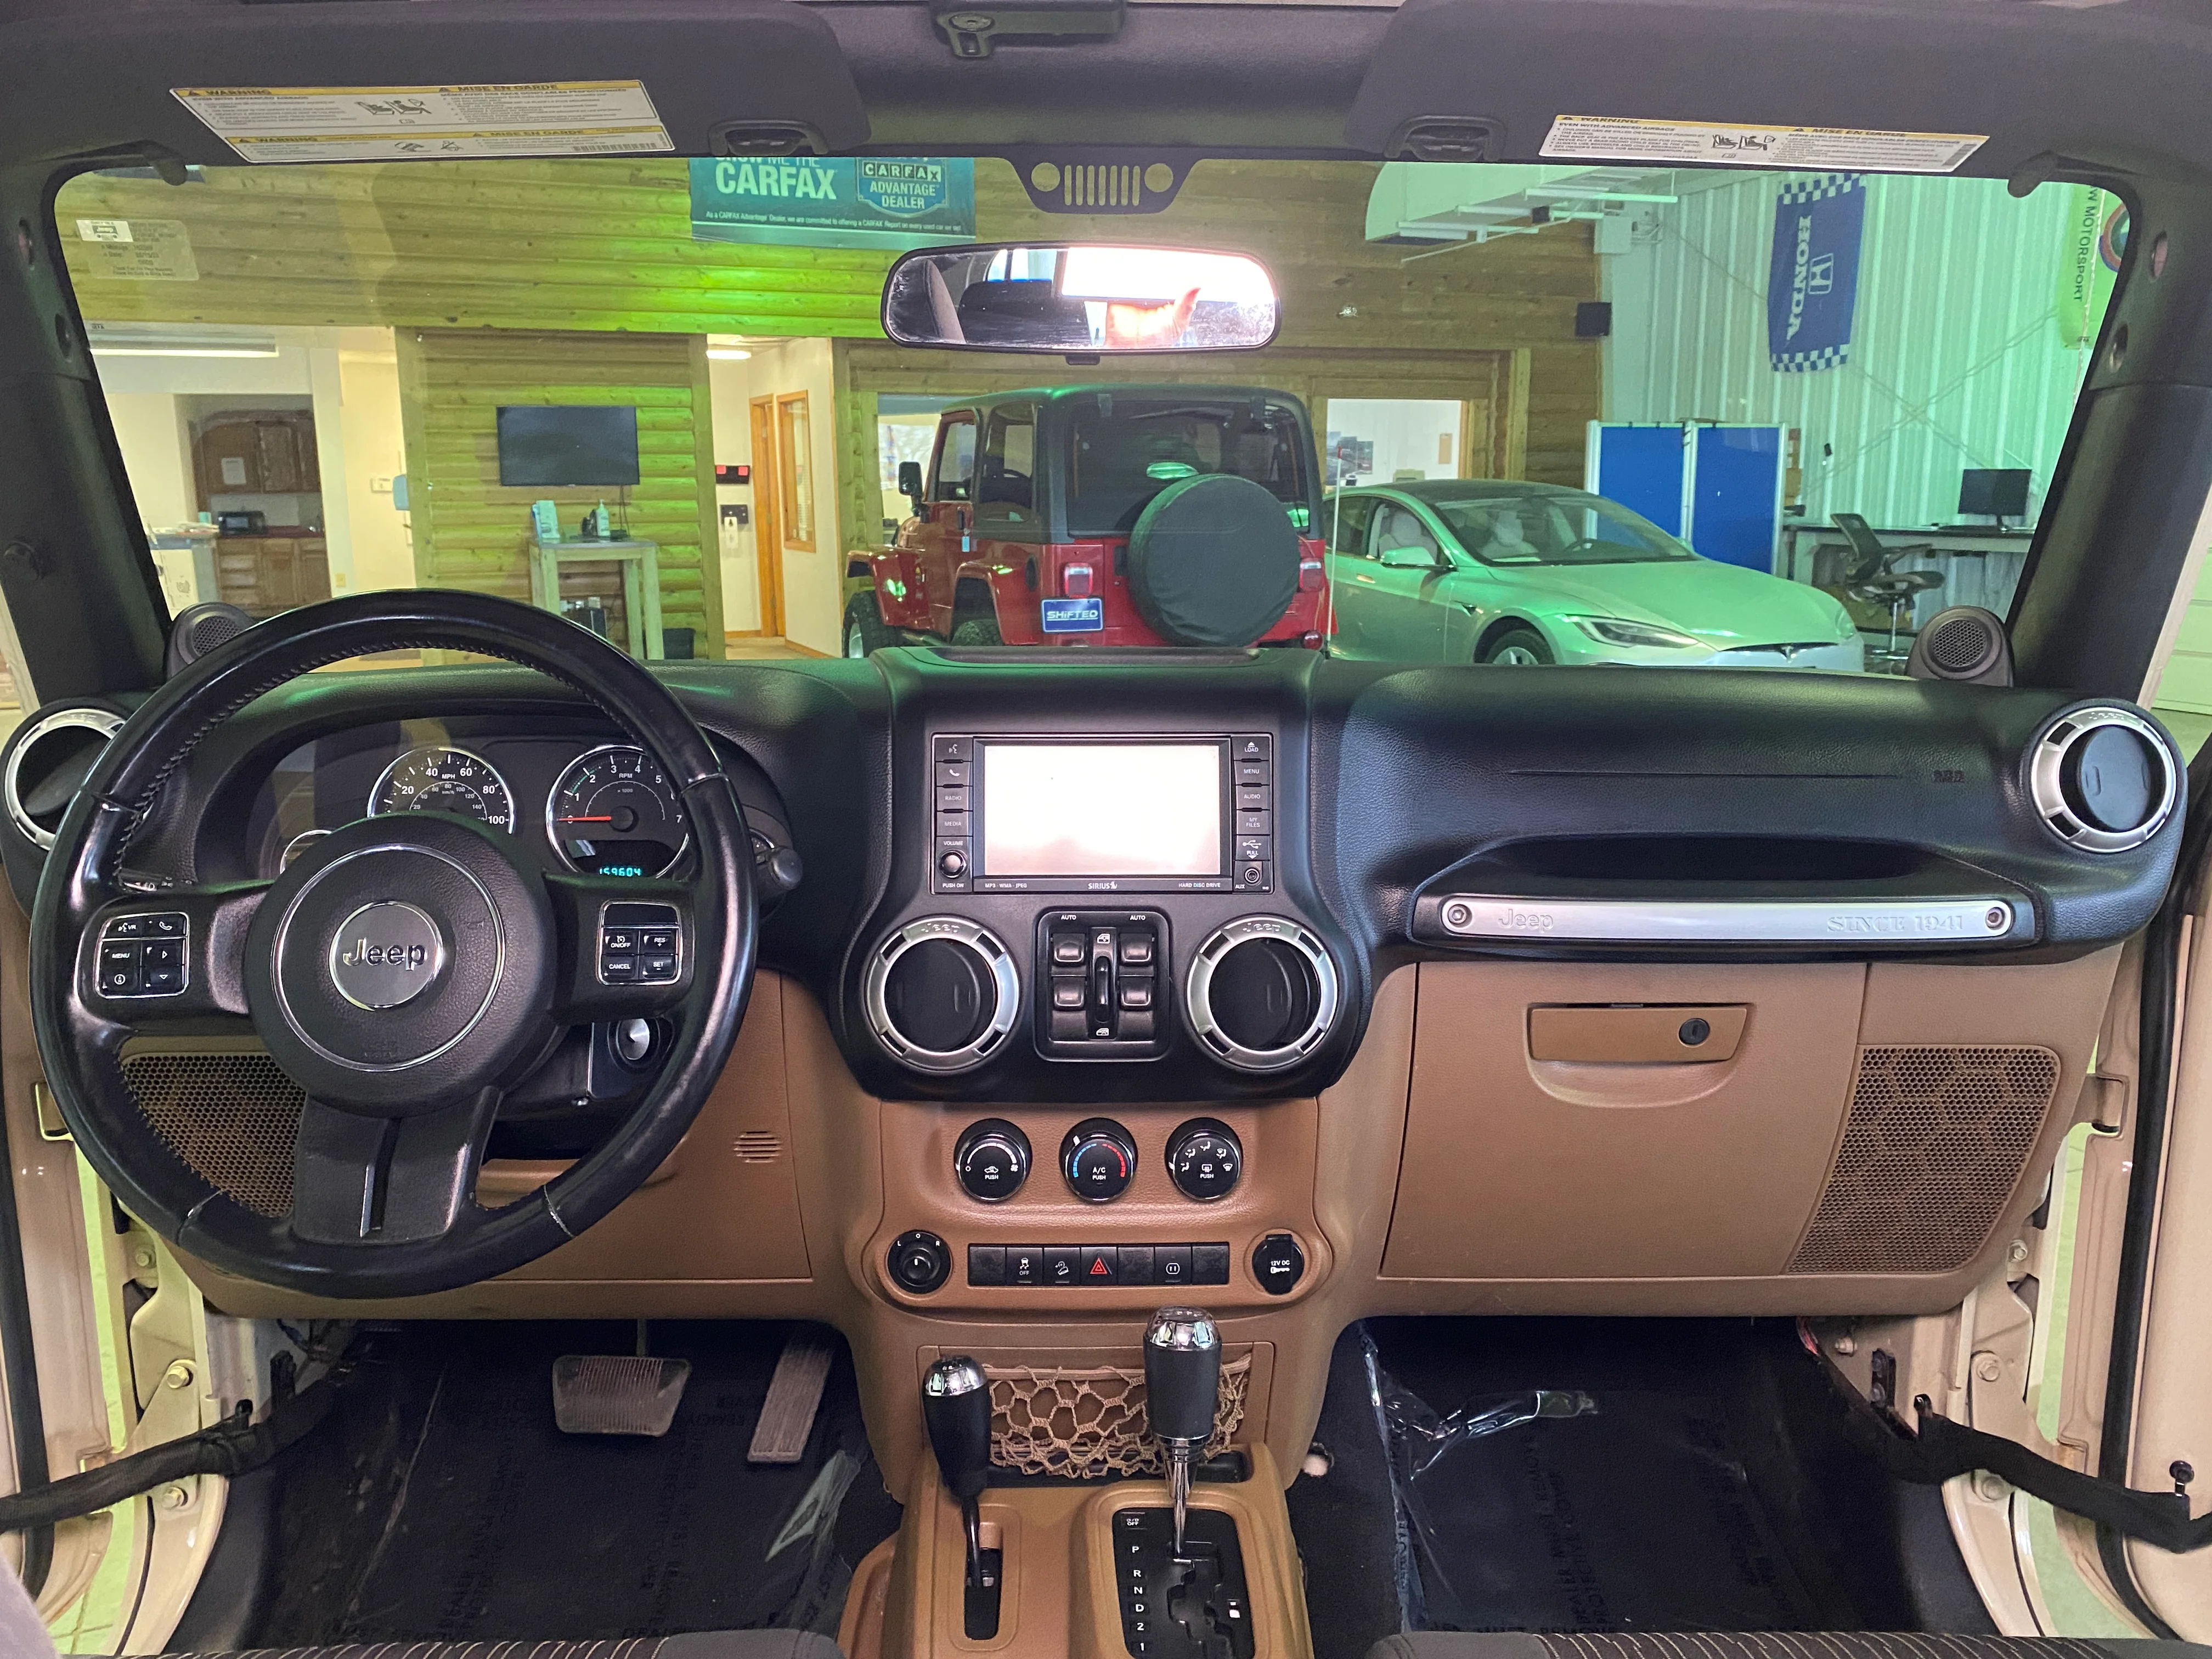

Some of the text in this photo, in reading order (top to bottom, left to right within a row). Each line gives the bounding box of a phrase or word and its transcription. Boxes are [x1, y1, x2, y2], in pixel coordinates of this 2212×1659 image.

[865, 163, 939, 181] CARFAX
[715, 161, 837, 200] CARFAX
[870, 180, 936, 196] ADVANTAGE
[882, 195, 926, 209] DEALER
[719, 211, 740, 219] CARFAX
[2074, 205, 2096, 302] MOTORSPORT
[1786, 215, 1812, 341] HONDA
[425, 768, 473, 776] 40 60
[611, 765, 641, 774] 3 4
[589, 774, 662, 783] 2 5
[402, 785, 495, 794] 20 80
[575, 793, 579, 801] 1
[488, 815, 505, 825] 100
[676, 815, 682, 823] 7
[599, 867, 641, 877] 159604
[1498, 908, 1554, 934] Jeep
[1827, 915, 1963, 933] SINCE 1941
[342, 936, 428, 971] Jeep
[1135, 1604, 1144, 1612] D
[1137, 1622, 1144, 1630] 2
[1140, 1643, 1144, 1651] 1
